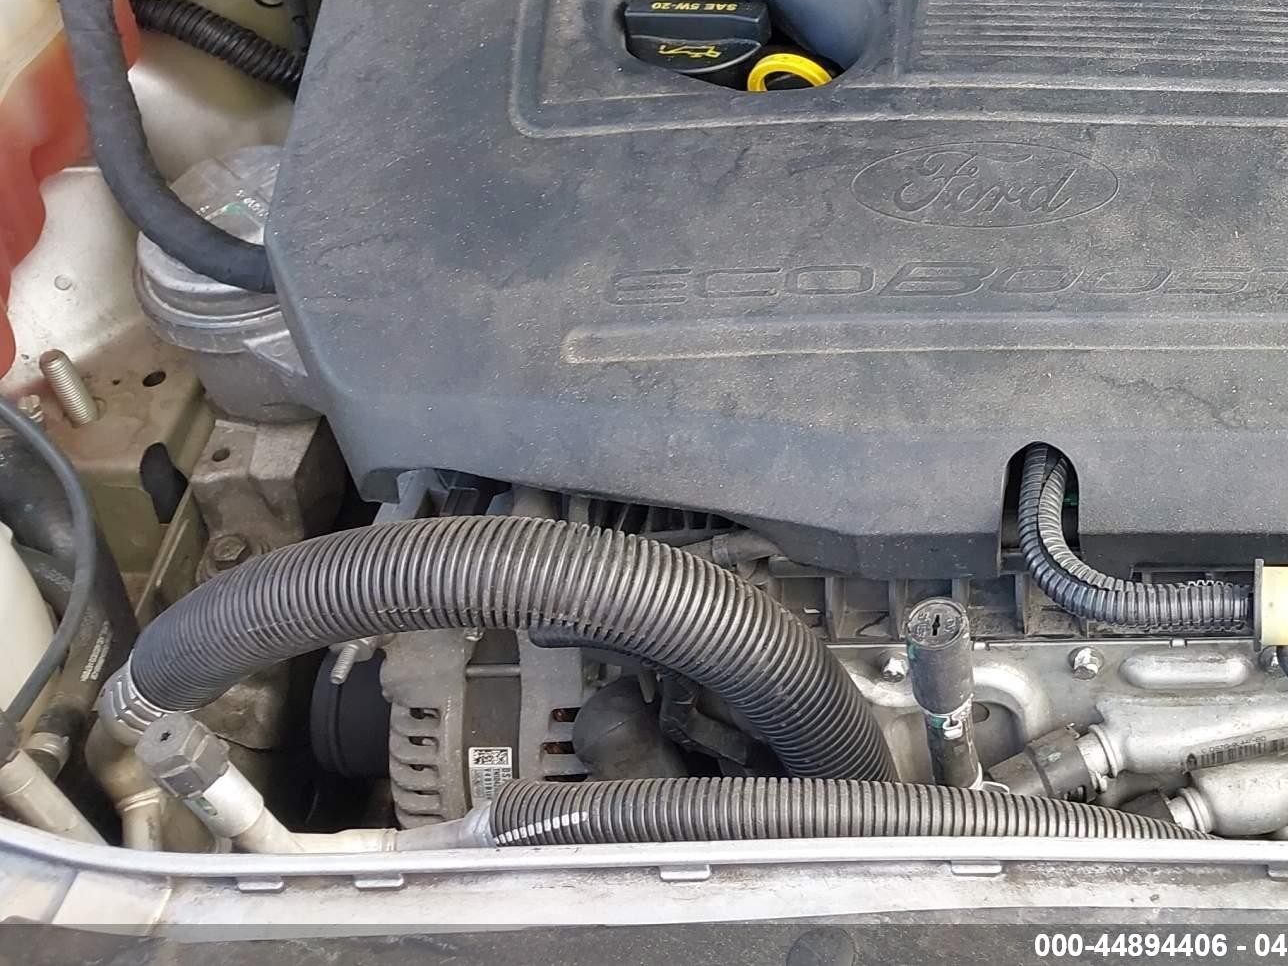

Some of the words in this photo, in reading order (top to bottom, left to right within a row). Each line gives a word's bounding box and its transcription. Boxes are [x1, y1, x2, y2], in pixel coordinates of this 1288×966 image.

[651, 1, 701, 11] 5W-20
[704, 2, 738, 11] SAE
[894, 148, 1076, 214] Ford
